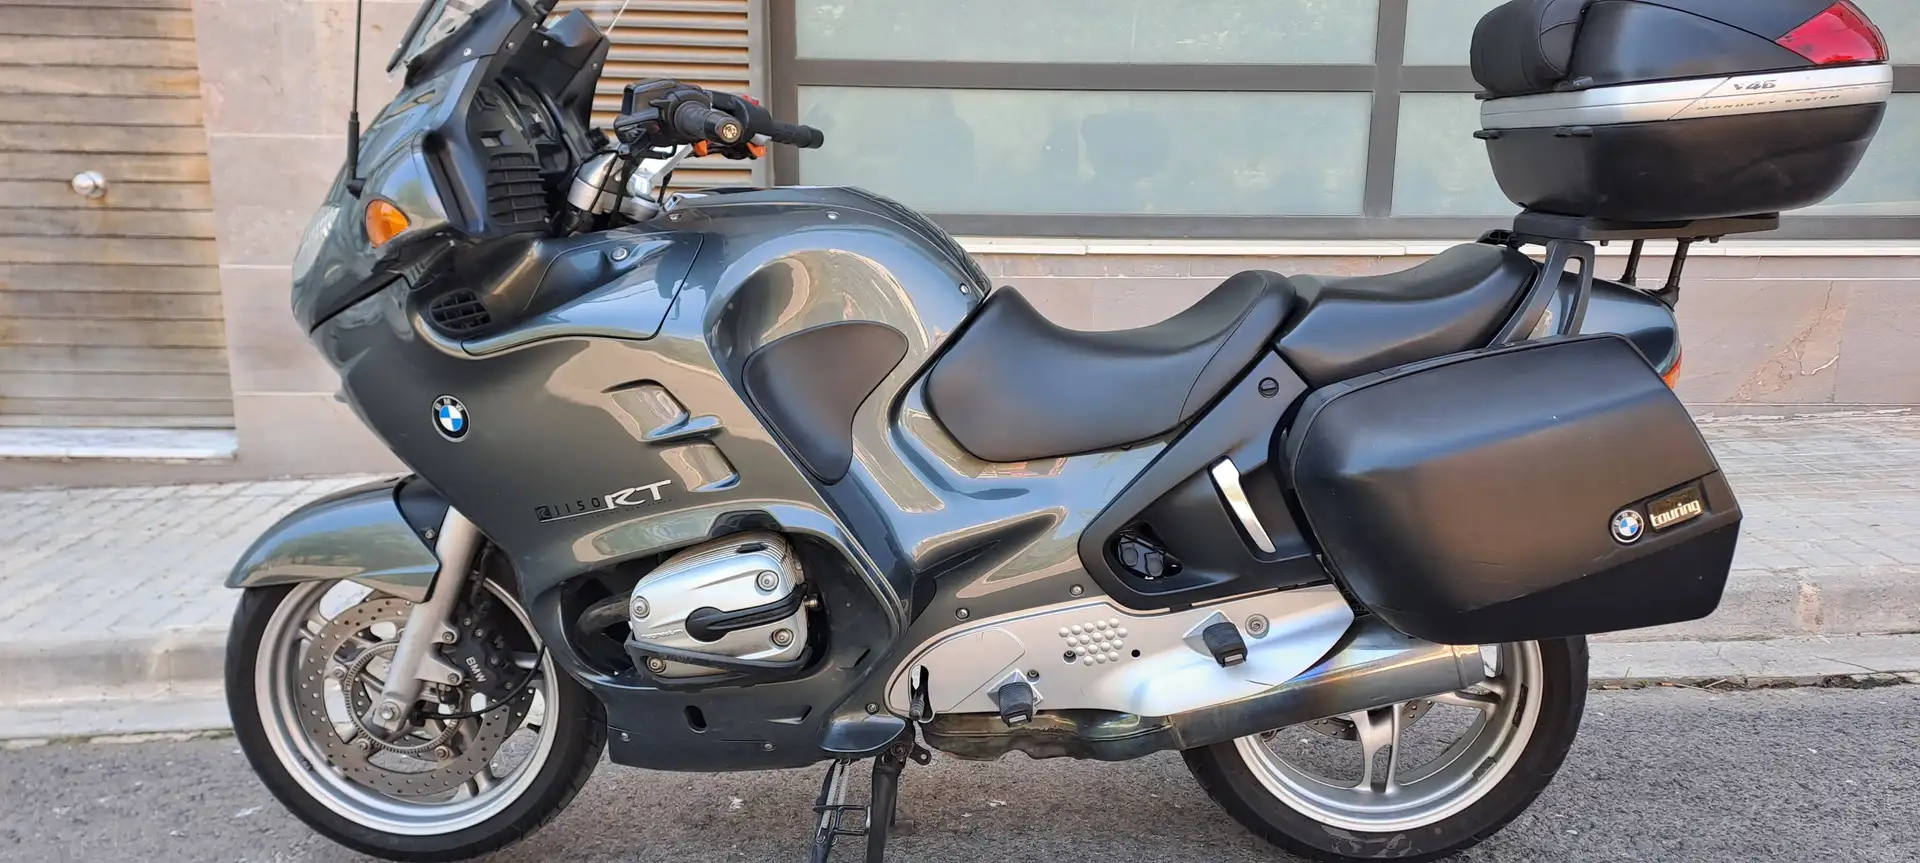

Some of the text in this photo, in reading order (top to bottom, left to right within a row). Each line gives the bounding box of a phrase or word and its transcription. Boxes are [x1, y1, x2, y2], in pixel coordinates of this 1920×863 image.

[434, 398, 464, 412] BMW
[1649, 500, 1702, 527] touring
[465, 656, 487, 683] BMW
